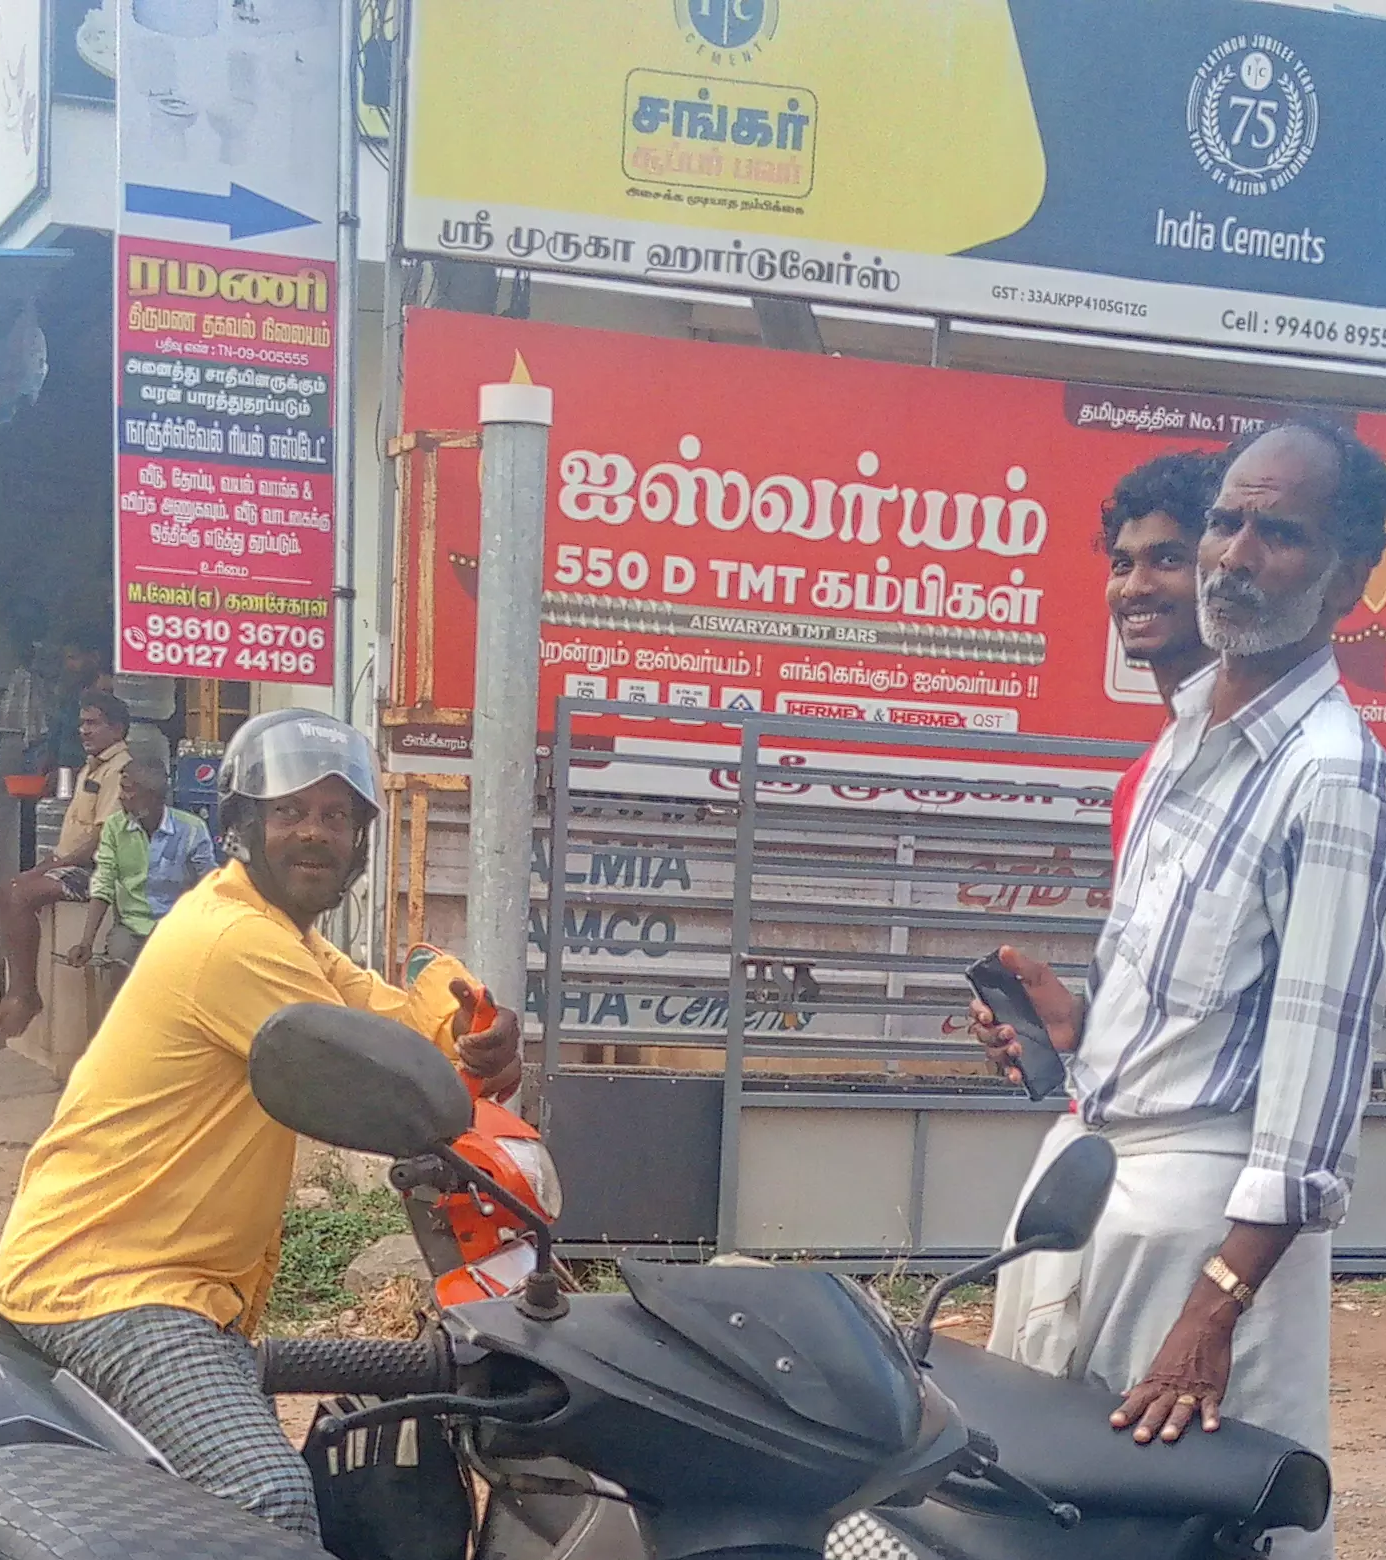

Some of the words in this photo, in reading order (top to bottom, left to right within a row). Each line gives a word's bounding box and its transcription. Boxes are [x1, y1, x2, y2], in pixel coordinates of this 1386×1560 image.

[685, 32, 763, 66] CEMENT
[1197, 35, 1247, 79] PLATINUM
[1251, 35, 1295, 63] JUBILEE
[1293, 60, 1315, 93] YEAR
[632, 87, 810, 151] சங்கர்
[1229, 95, 1279, 149] 75
[1189, 131, 1213, 171] YEARS
[1211, 167, 1227, 184] OF
[1227, 177, 1268, 196] NATION
[1270, 145, 1313, 192] BUILDING
[507, 216, 632, 264] முருகா
[647, 240, 901, 293] ஹார்டுவேர்ஸ்
[1155, 208, 1214, 251] India
[1221, 216, 1326, 266] Cements
[127, 254, 328, 312] ரமணி
[991, 285, 1018, 301] GST
[128, 301, 196, 332] திருமண
[202, 312, 256, 339] தகவல்
[262, 317, 331, 347] நிலையம்
[1221, 310, 1259, 333] Cell
[1275, 316, 1339, 342] 99406
[125, 357, 201, 386] அனைத்து
[205, 366, 327, 394] சாதியினருக்கும்
[218, 344, 309, 365] TN-09-005555
[140, 384, 183, 404] வரன்
[1078, 401, 1185, 432] தமிழகத்தின்
[1189, 418, 1225, 432] No.1
[125, 412, 223, 452] நாஞ்சில்வேல்
[228, 424, 265, 456] ரியல்
[269, 428, 327, 464] எஸ்டேட்
[558, 433, 1049, 558] ஐஸ்வர்யம்
[555, 544, 649, 591] 550
[663, 555, 696, 596] D
[709, 559, 805, 605] TMT
[812, 555, 1043, 625] கம்பிகள்
[146, 614, 231, 643] 93610
[238, 621, 325, 650] 36706
[690, 613, 794, 639] AISWARYAM
[795, 622, 832, 642] TMT
[834, 624, 879, 645] BARS
[147, 640, 228, 668] 80127
[235, 648, 316, 675] 44196
[634, 646, 751, 677] ஐஸ்வர்யம்
[778, 657, 907, 692] எங்கெங்கும்
[912, 664, 1022, 699] ஐஸ்வர்யம்
[972, 712, 1003, 728] QST
